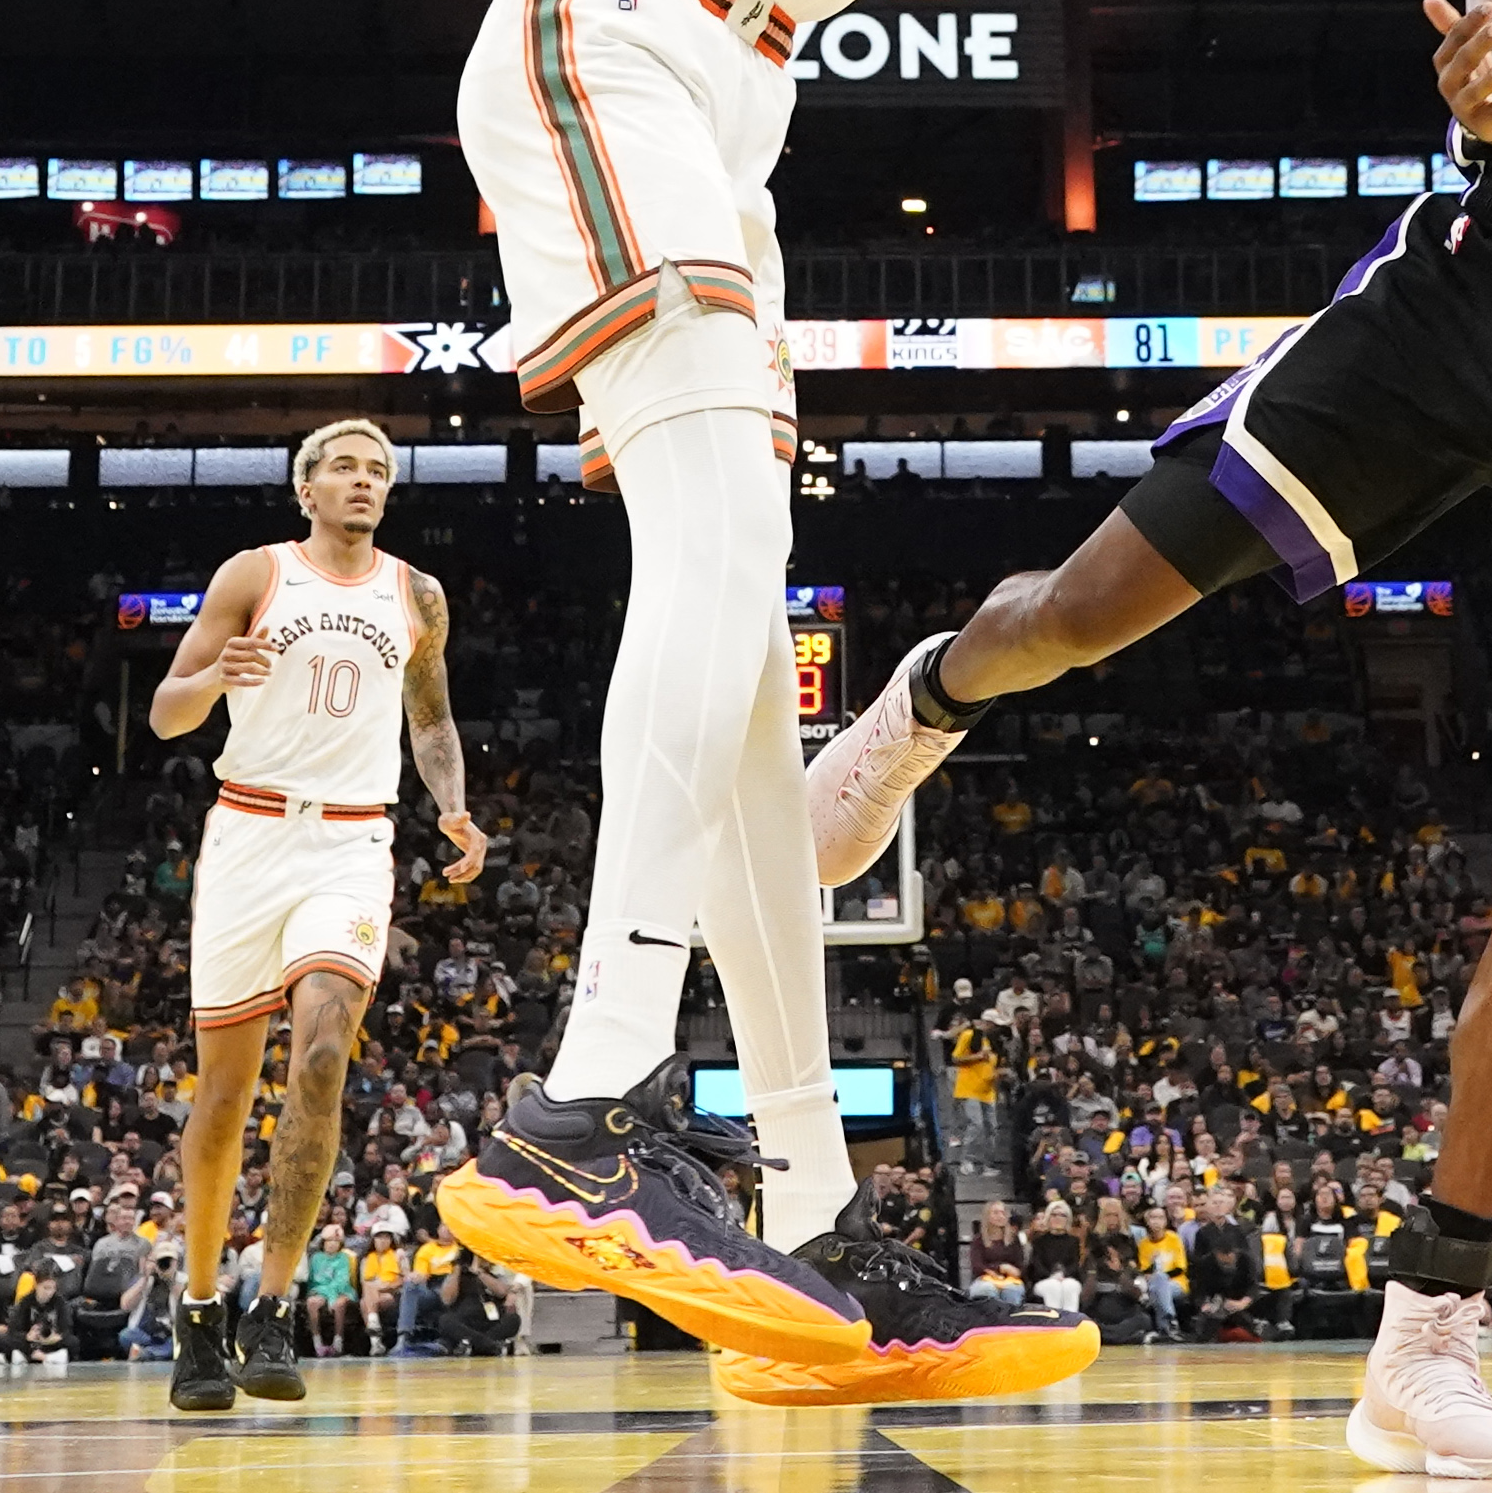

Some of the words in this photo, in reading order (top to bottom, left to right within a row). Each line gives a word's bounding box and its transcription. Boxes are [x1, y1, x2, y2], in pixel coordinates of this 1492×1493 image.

[5, 337, 47, 365] TO
[111, 336, 192, 364] FG%
[224, 332, 260, 365] 44
[290, 336, 332, 362] PF
[357, 332, 374, 365] 2
[892, 347, 958, 361] KINGS
[1005, 326, 1095, 358] SAC
[1135, 323, 1174, 362] 81
[1214, 328, 1255, 354] PF
[320, 613, 399, 669] ANTONIO
[795, 633, 831, 664] 39
[307, 654, 361, 718] 10
